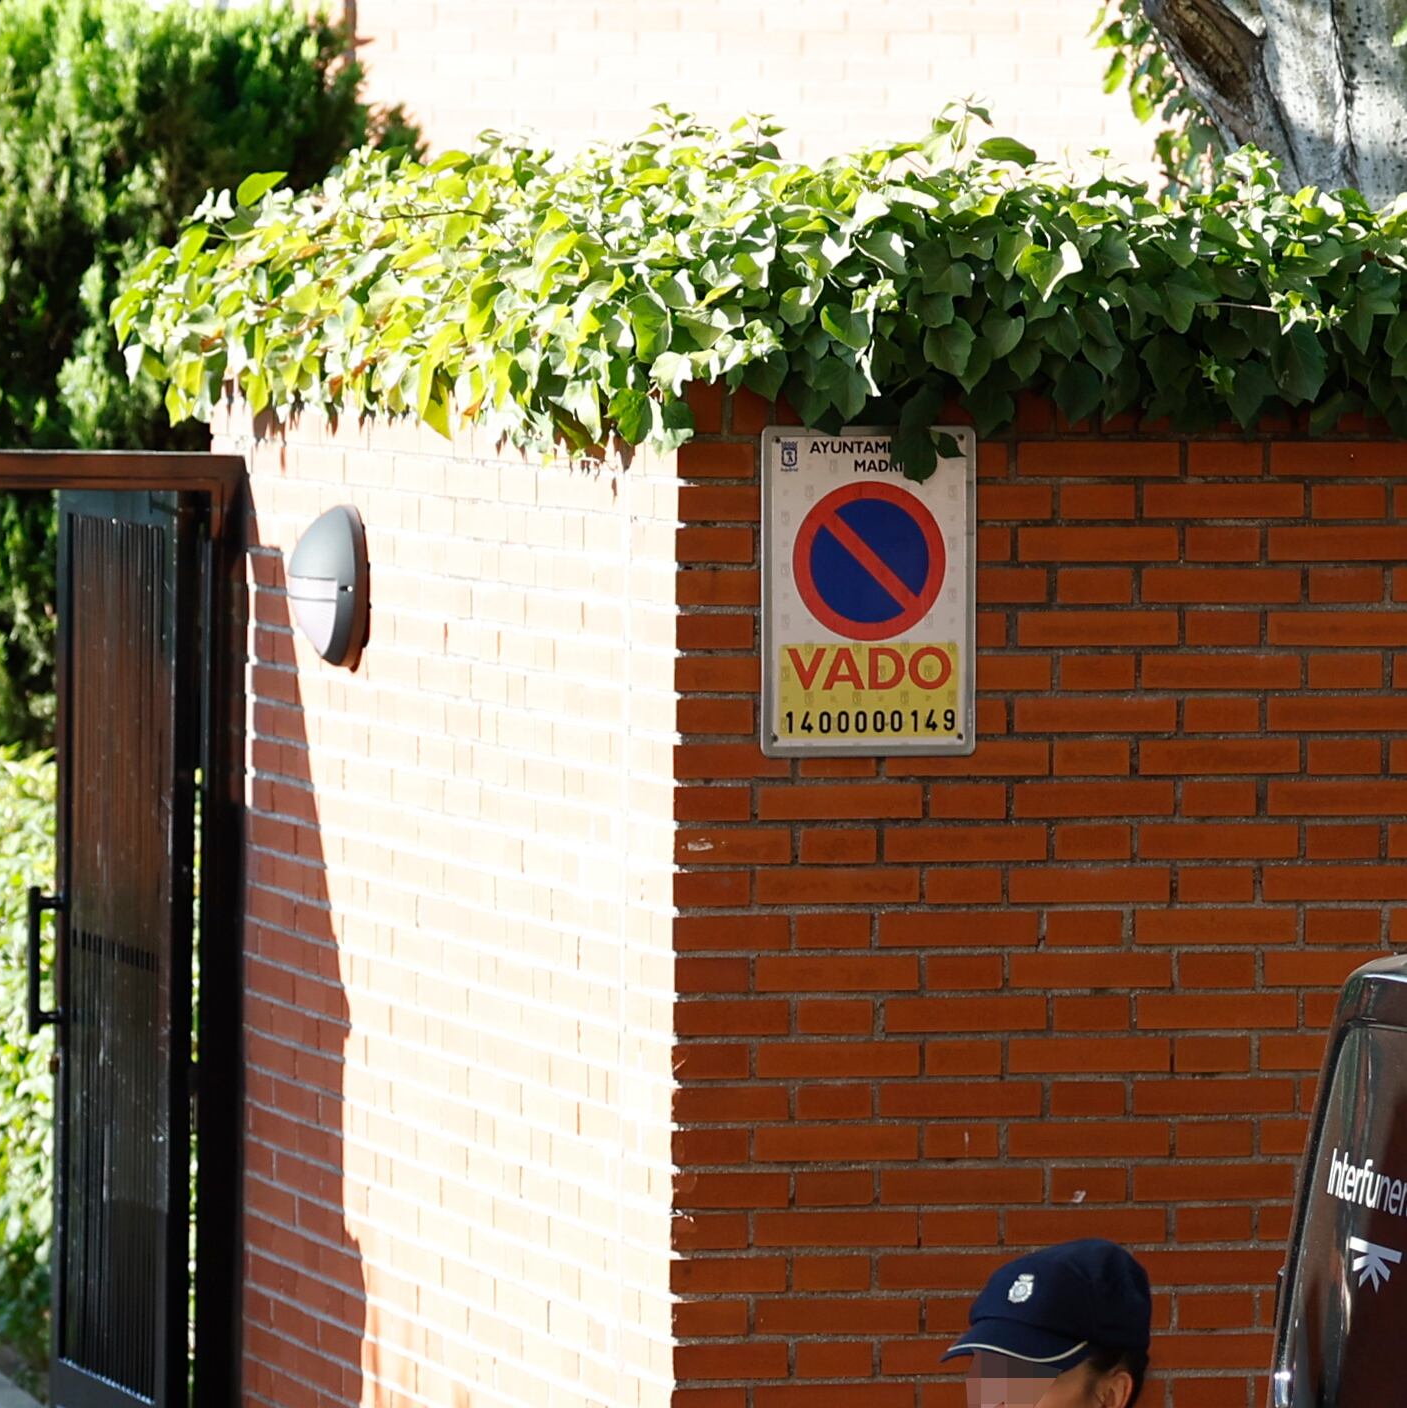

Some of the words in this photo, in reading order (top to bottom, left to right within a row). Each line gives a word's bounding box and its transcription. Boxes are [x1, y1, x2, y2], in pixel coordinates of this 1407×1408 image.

[809, 441, 891, 454] AYUNTAMI
[854, 460, 903, 473] MADRI
[787, 647, 952, 690] VADO
[786, 709, 956, 734] 1400000149
[1327, 1148, 1407, 1217] Interfuner
